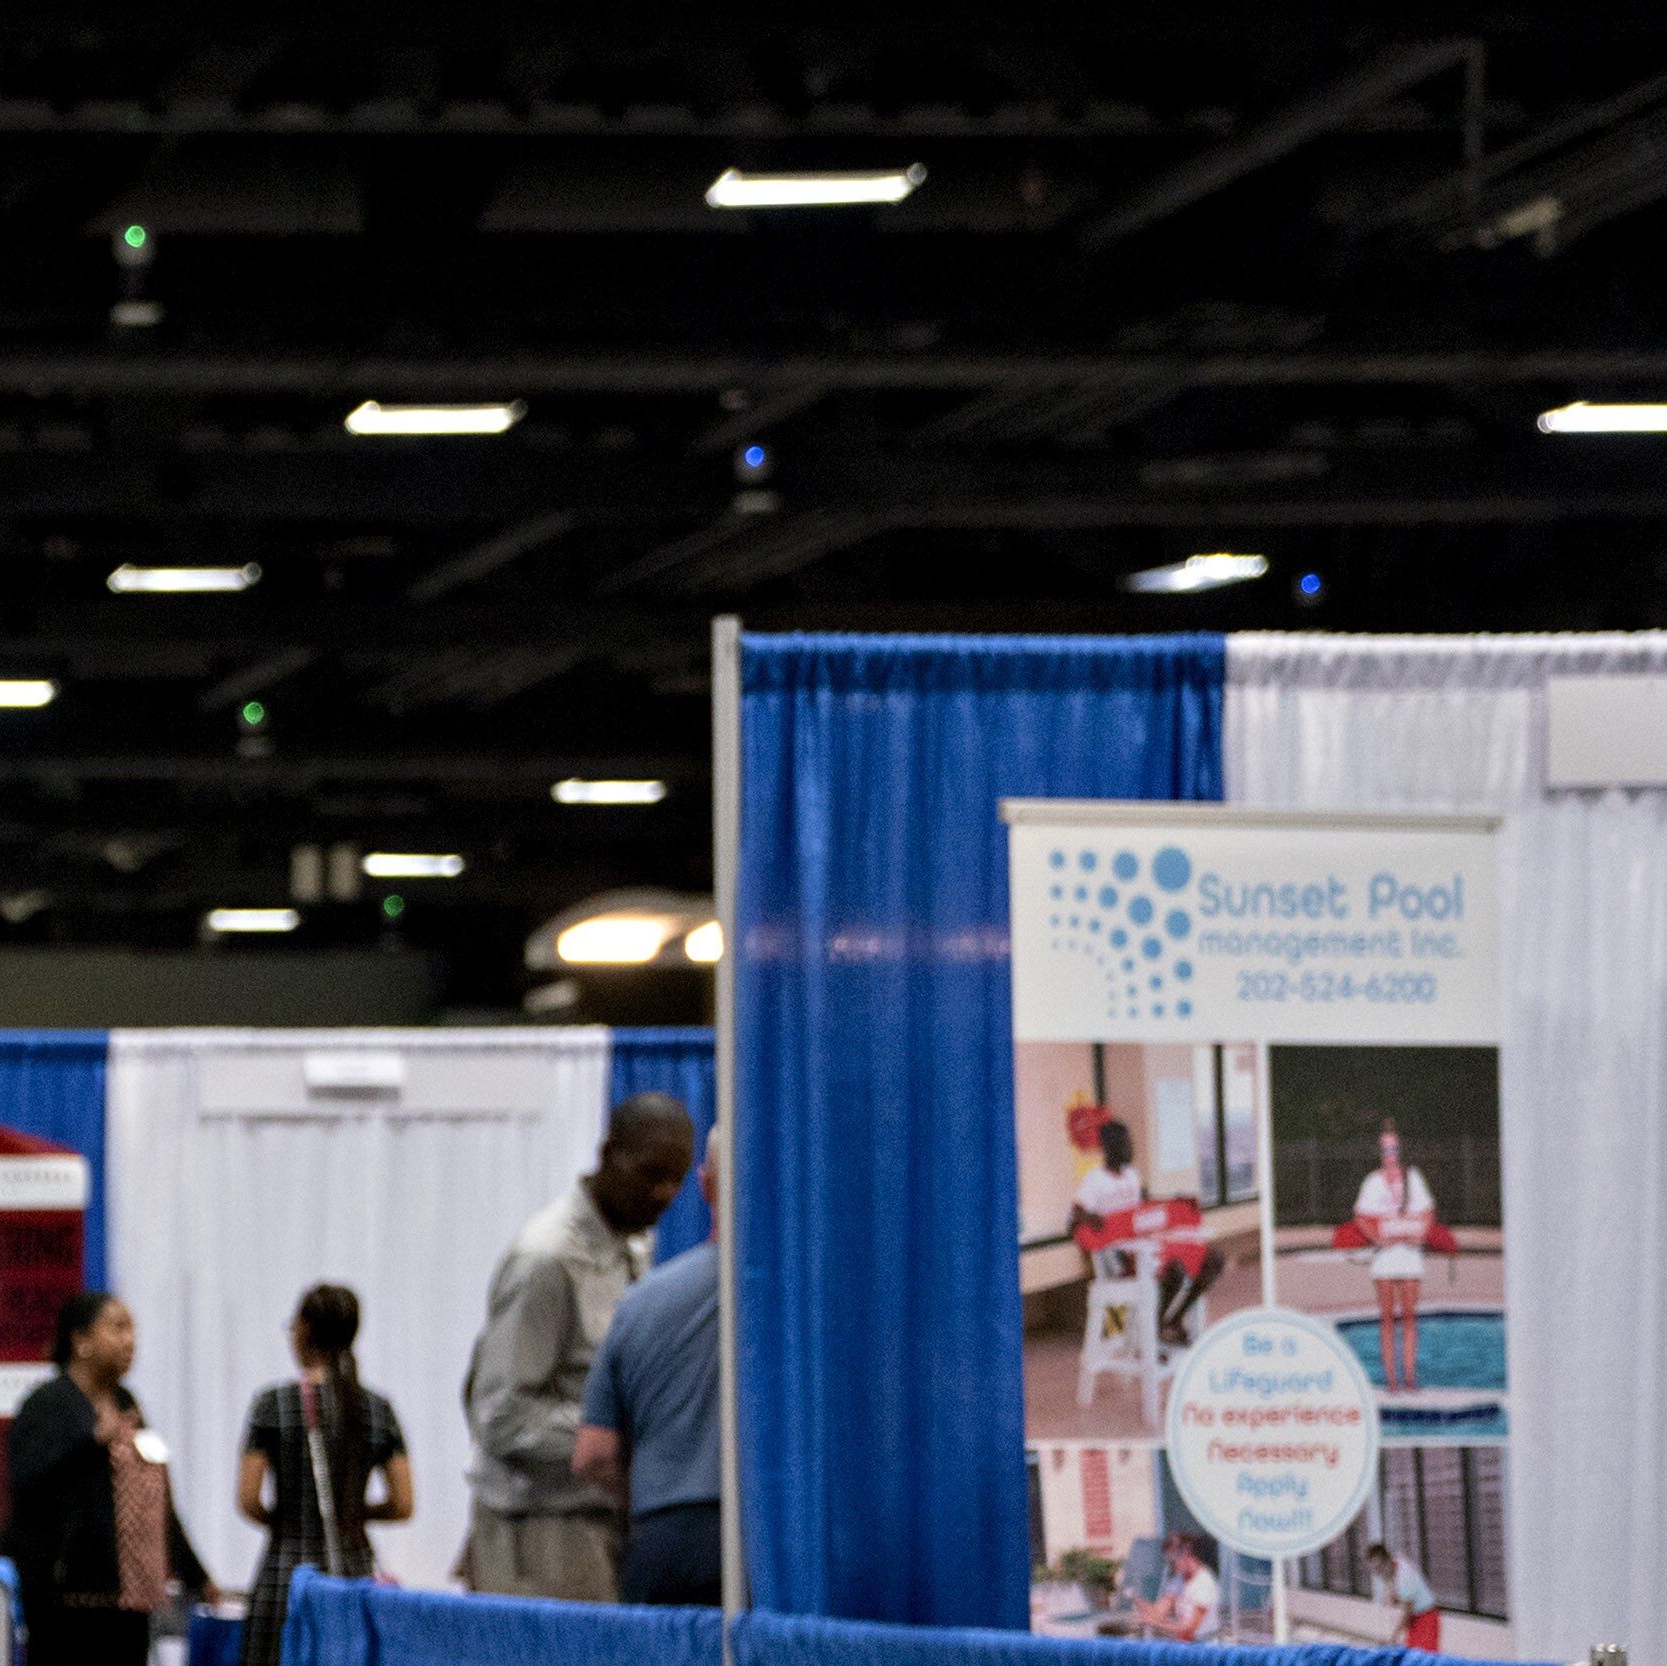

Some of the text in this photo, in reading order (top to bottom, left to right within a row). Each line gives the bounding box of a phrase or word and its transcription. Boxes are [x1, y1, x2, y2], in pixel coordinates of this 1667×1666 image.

[1197, 870, 1465, 921] Sunset Pool
[1197, 928, 1465, 965] management Inc.
[1243, 1334, 1274, 1356] Be
[1207, 1367, 1333, 1399] Lifeguard
[1221, 1404, 1362, 1430] experience
[1206, 1438, 1340, 1469] Necessary
[1236, 1472, 1309, 1500] Apply
